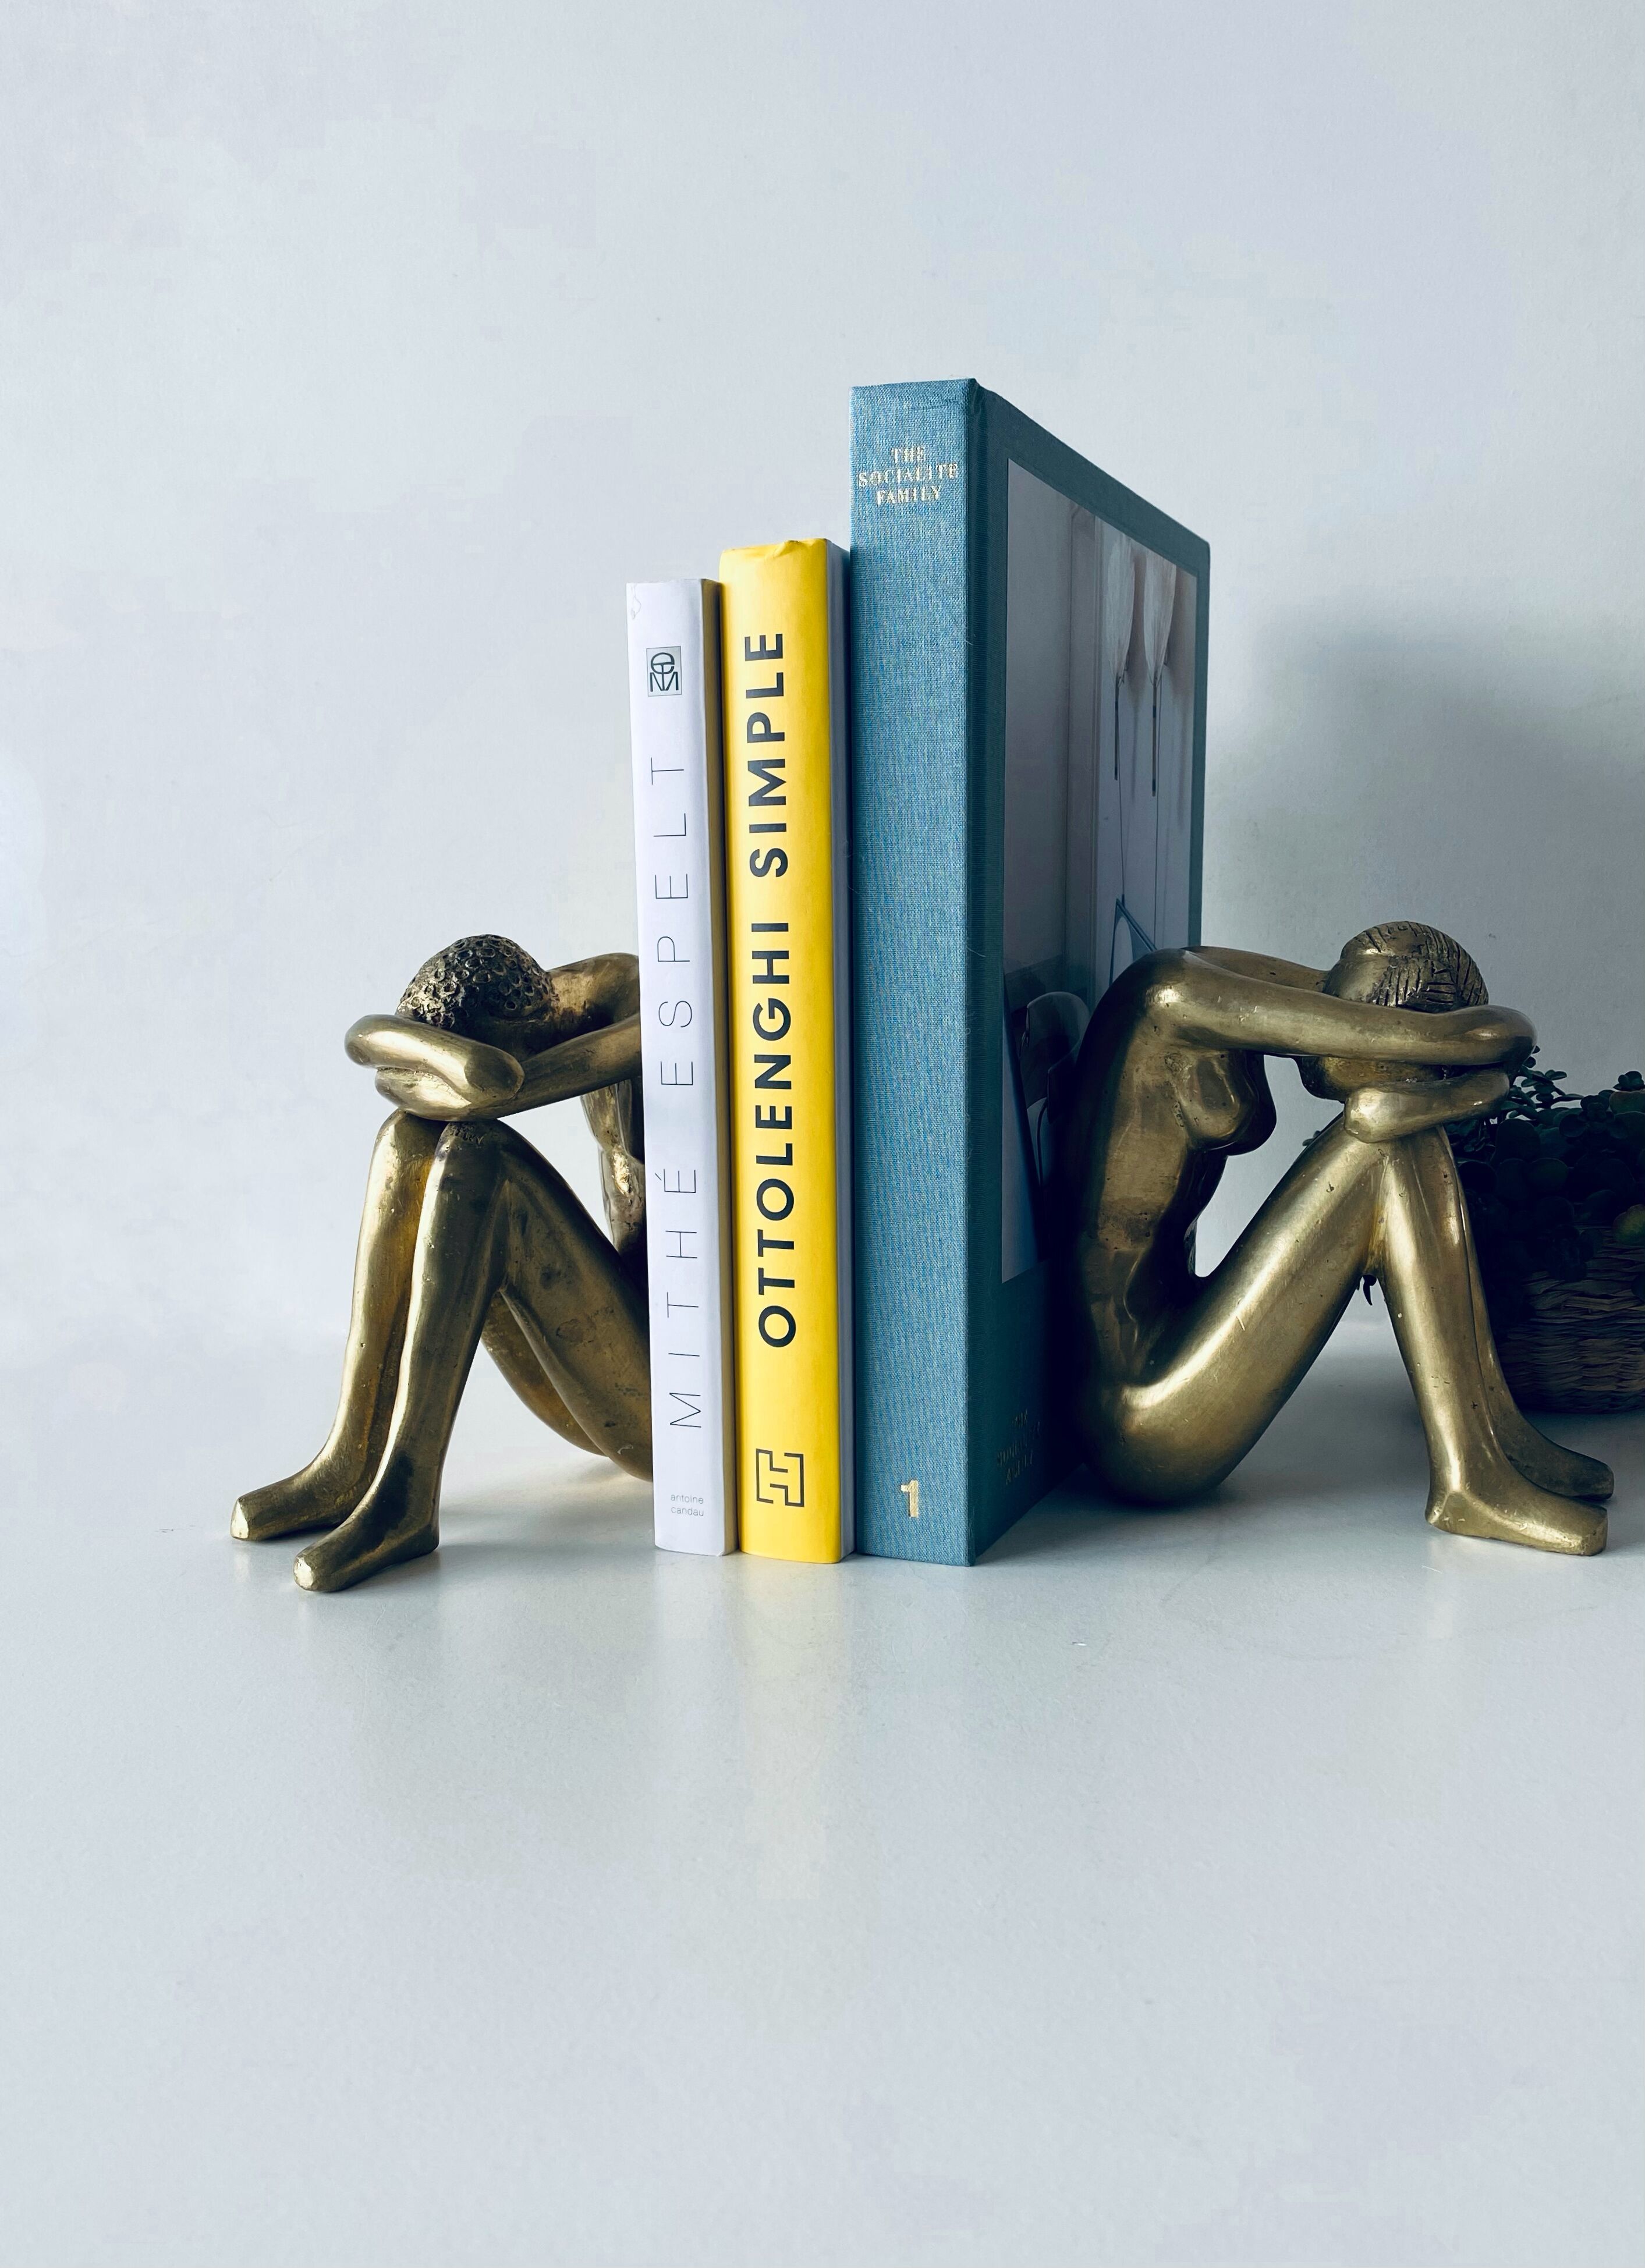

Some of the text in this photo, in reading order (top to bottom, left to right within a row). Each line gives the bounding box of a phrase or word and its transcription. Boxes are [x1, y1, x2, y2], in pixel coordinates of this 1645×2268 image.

[891, 446, 926, 464] THE
[857, 462, 958, 487] SOCIALITE
[876, 485, 941, 505] FAMILY
[744, 633, 797, 1348] OTTOLENGHI SIMPLE
[650, 757, 702, 1429] MITHÉ ESPELT
[670, 1494, 704, 1504] antoine
[901, 1480, 919, 1518] 1
[671, 1506, 704, 1517] candau
